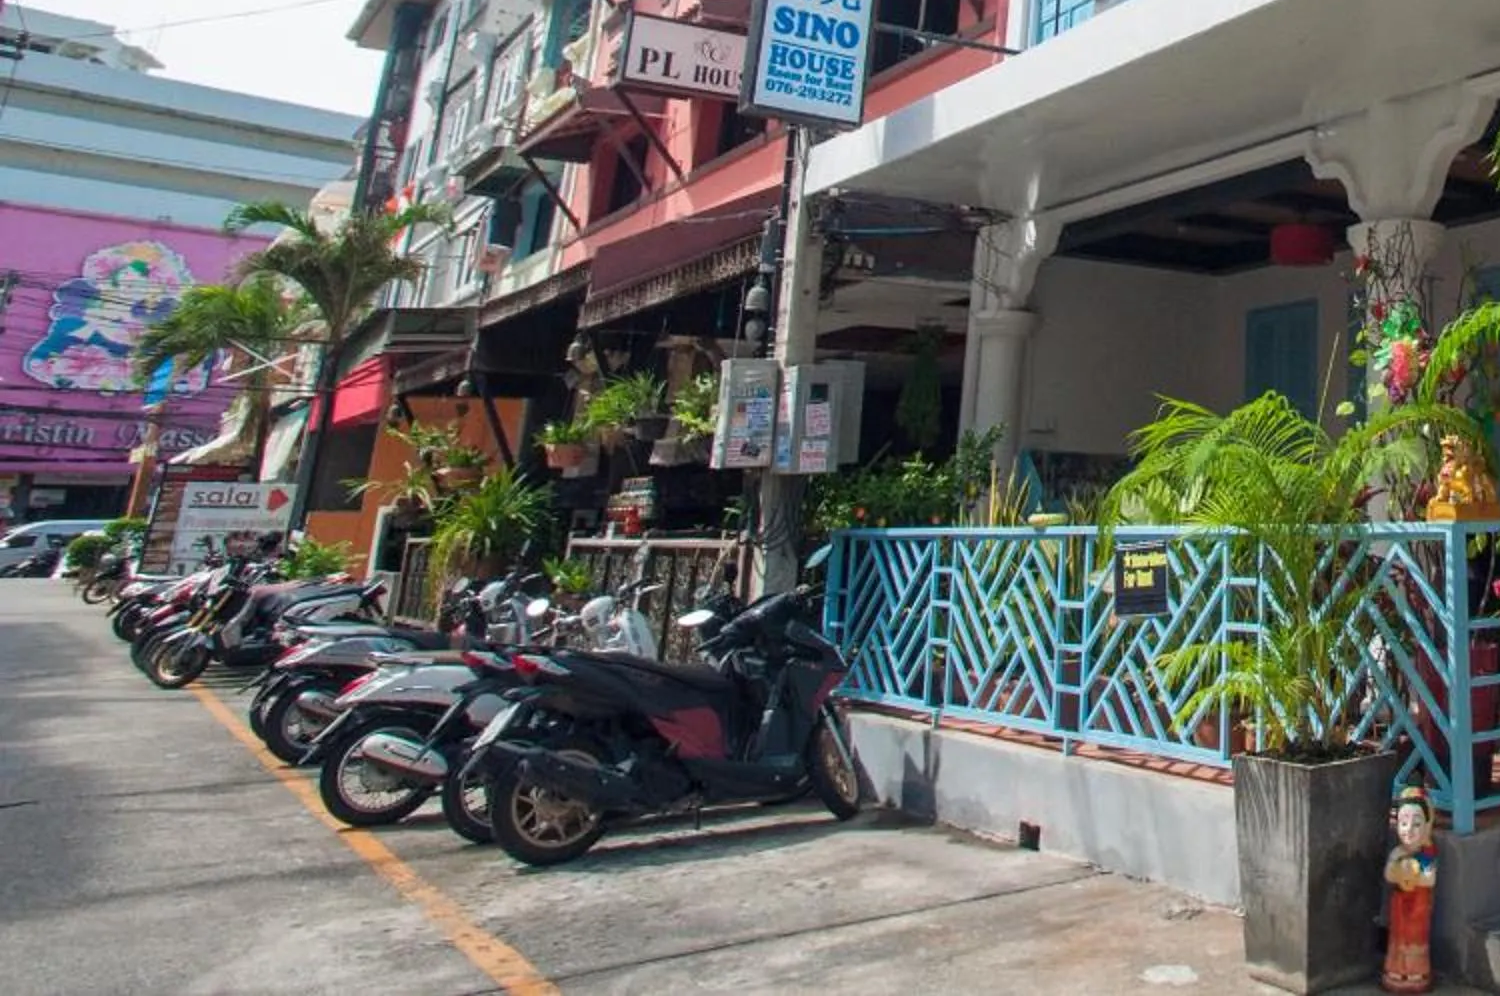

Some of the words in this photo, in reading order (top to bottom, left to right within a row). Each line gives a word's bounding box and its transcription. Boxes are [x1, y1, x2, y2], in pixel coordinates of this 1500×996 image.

[773, 6, 860, 49] SINO
[639, 47, 680, 79] PL
[693, 65, 746, 89] HOU
[770, 44, 855, 81] HOUSE
[191, 486, 252, 505] sala
